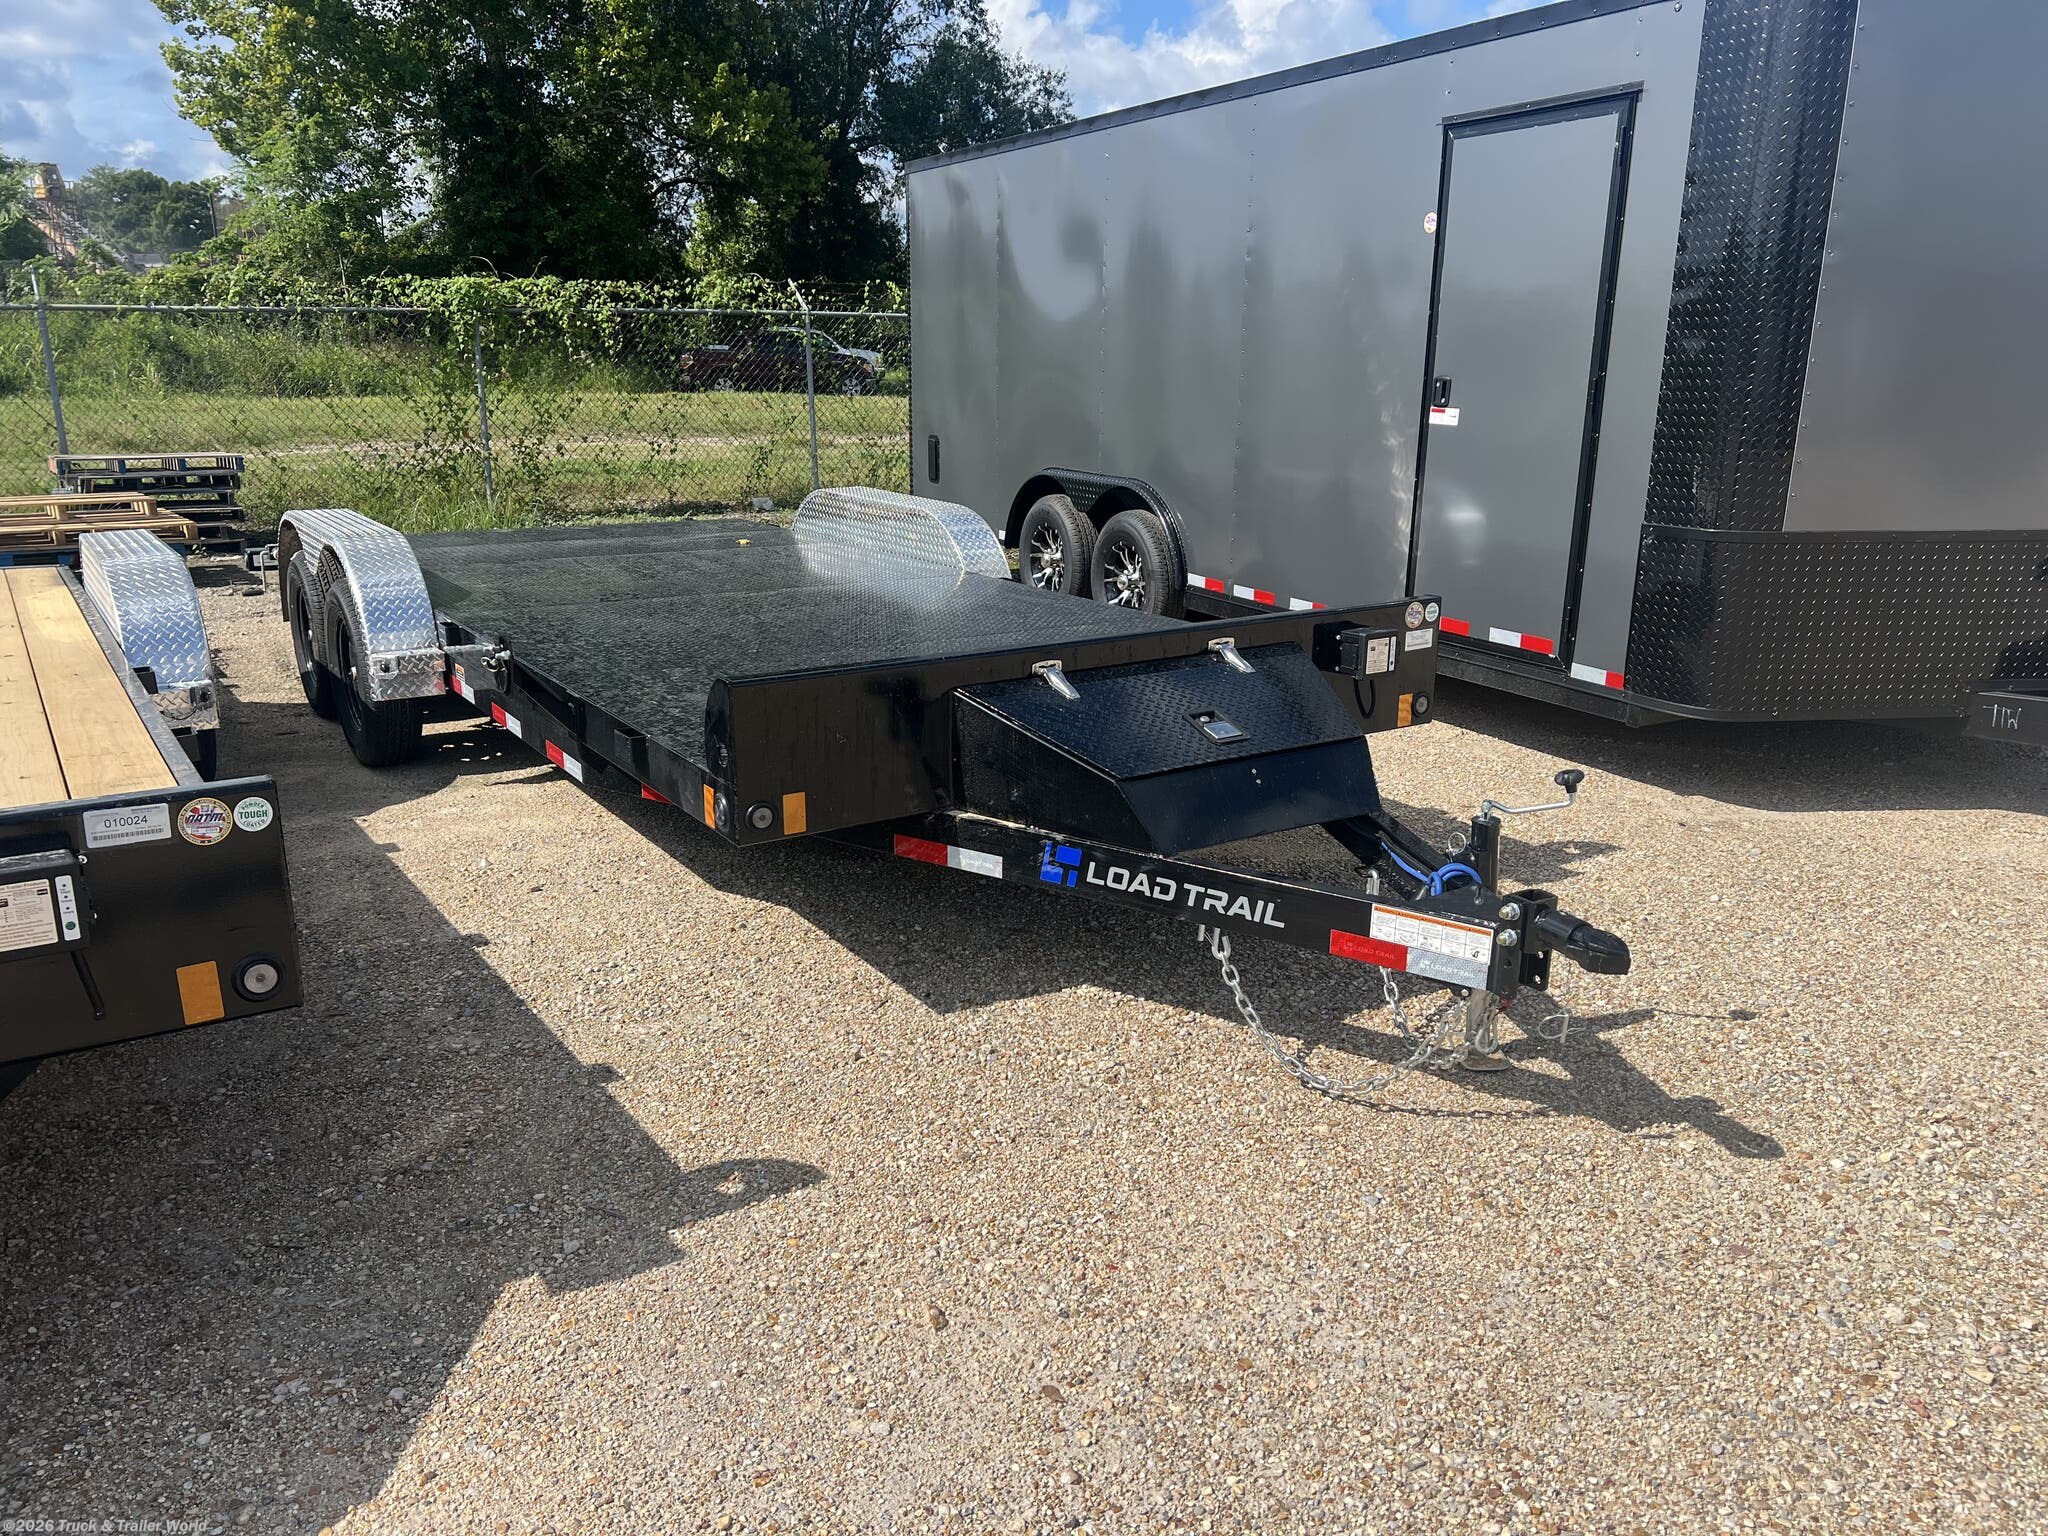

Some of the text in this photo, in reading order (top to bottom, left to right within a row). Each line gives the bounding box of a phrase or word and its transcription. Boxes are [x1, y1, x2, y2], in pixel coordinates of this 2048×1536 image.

[239, 810, 268, 819] TOUGH
[104, 815, 148, 828] 010024
[1086, 861, 1285, 929] LOAD TRAIL
